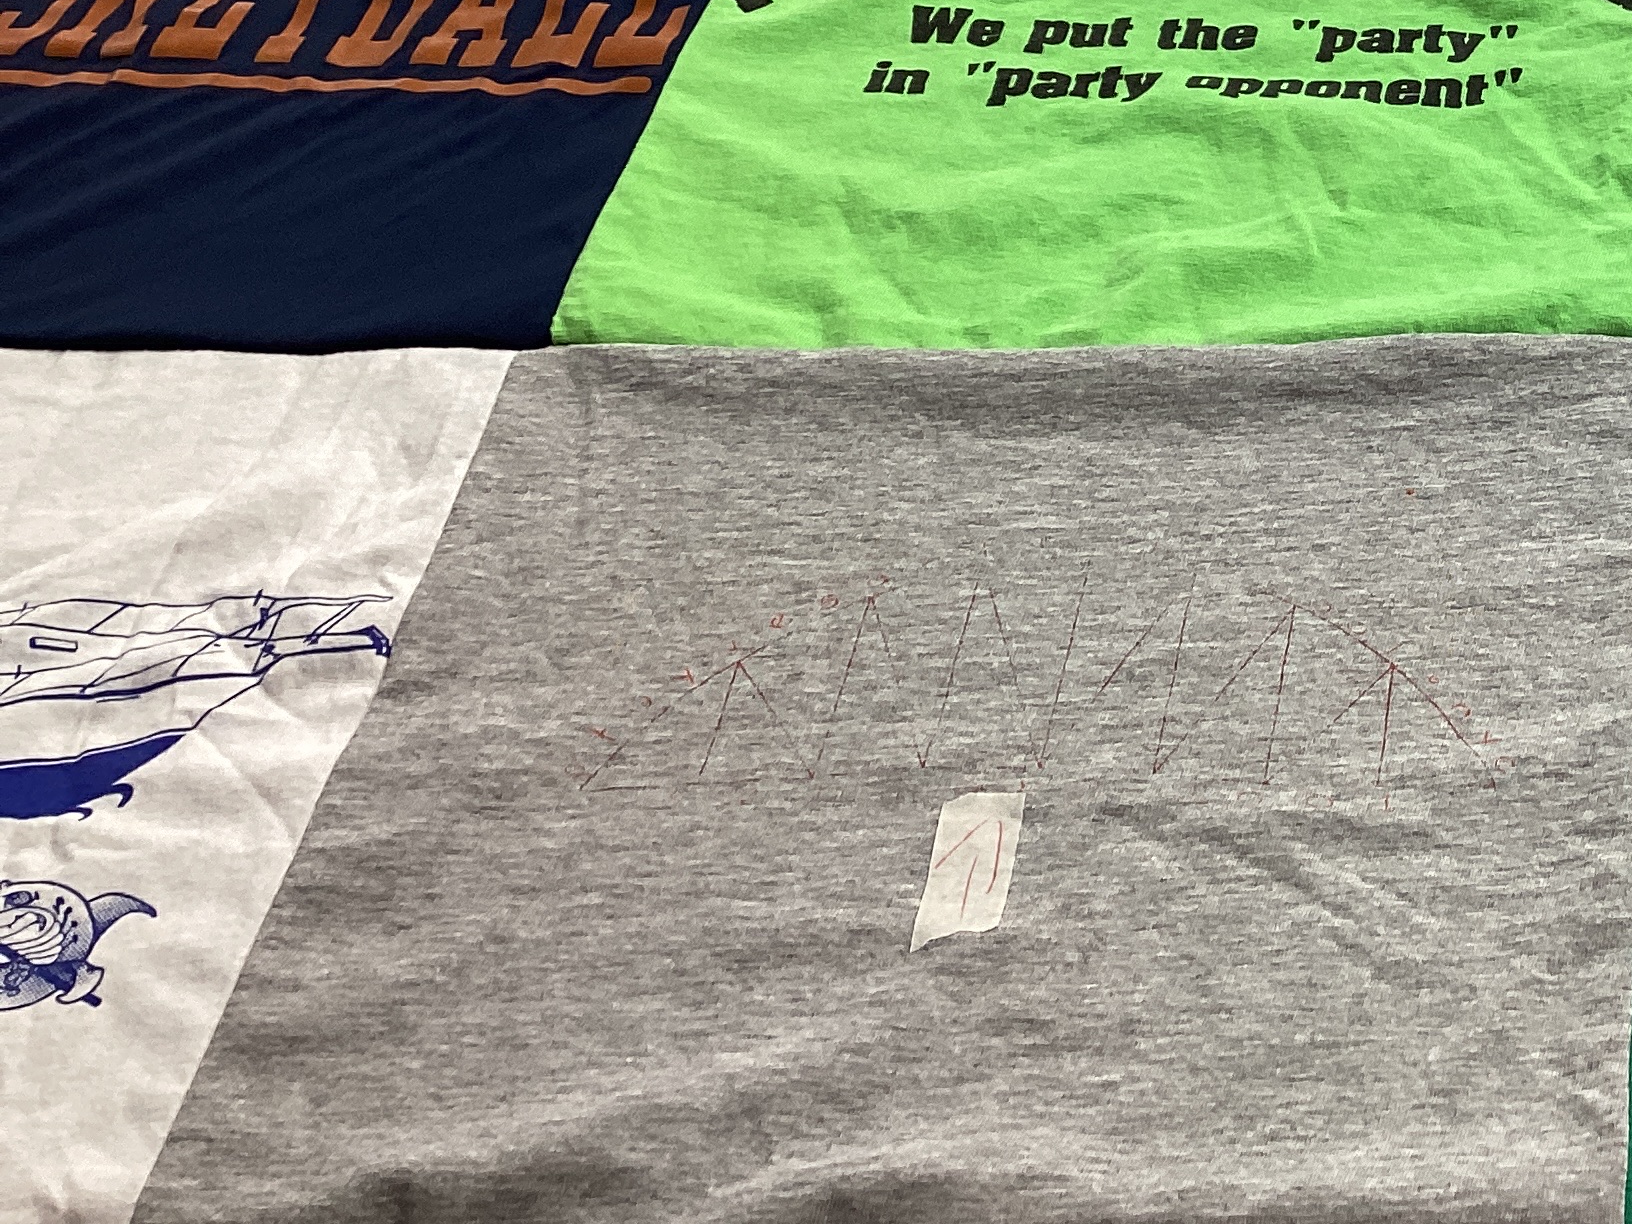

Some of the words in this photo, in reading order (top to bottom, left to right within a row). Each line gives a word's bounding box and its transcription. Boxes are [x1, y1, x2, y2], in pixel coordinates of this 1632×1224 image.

[907, 6, 1003, 49] We
[1023, 17, 1134, 54] put
[1157, 17, 1257, 52] the
[1291, 20, 1519, 62] "party"
[862, 60, 929, 96] in
[966, 60, 1159, 107] "party
